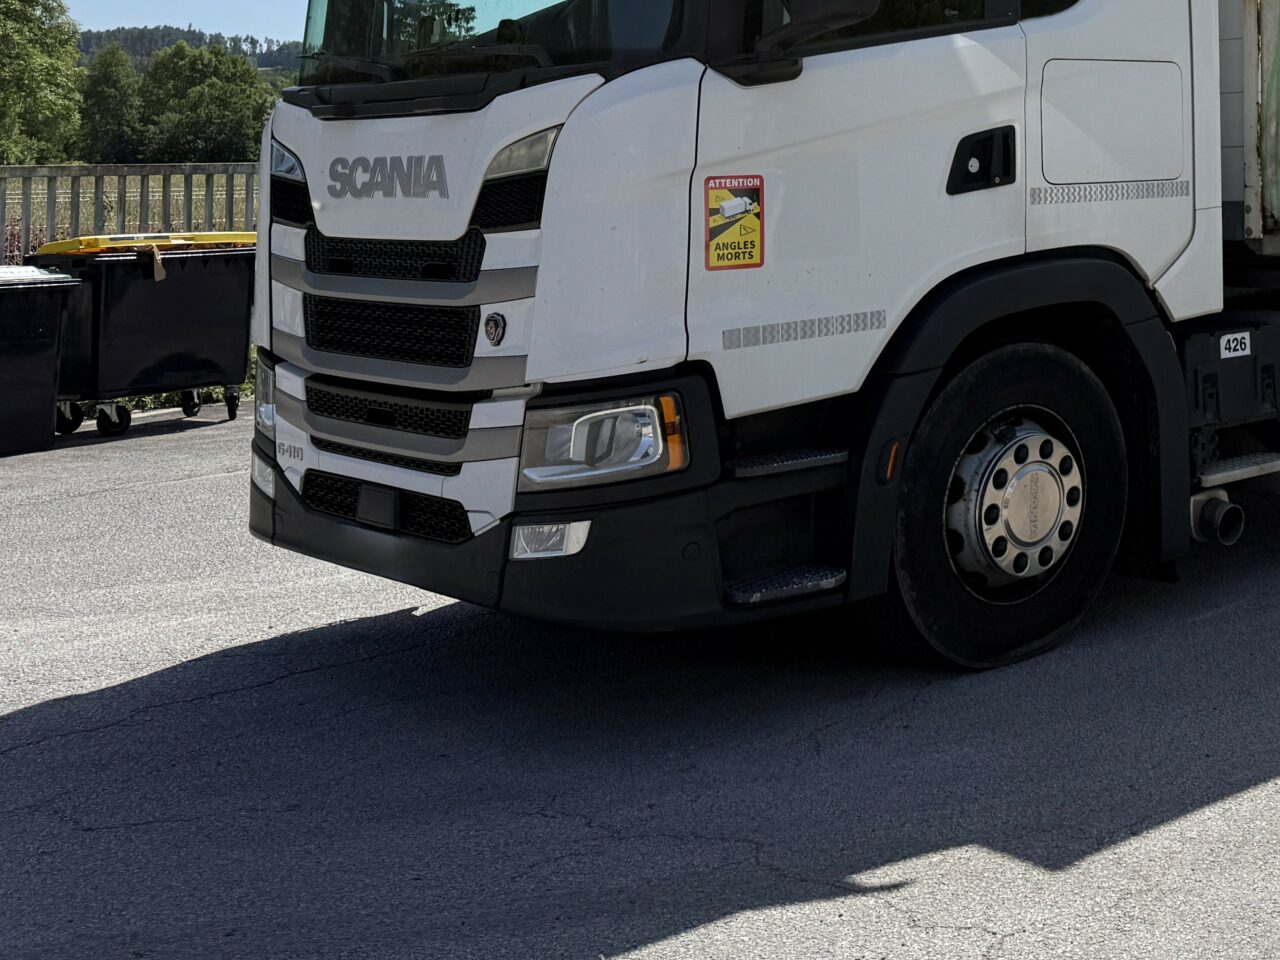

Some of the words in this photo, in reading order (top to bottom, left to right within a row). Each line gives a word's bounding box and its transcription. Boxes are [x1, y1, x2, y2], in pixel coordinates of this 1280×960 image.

[327, 154, 449, 200] SCANIA
[708, 178, 760, 189] ATTENTION
[714, 240, 756, 252] ANGLES
[716, 251, 755, 263] MORTS
[1224, 336, 1247, 353] 426
